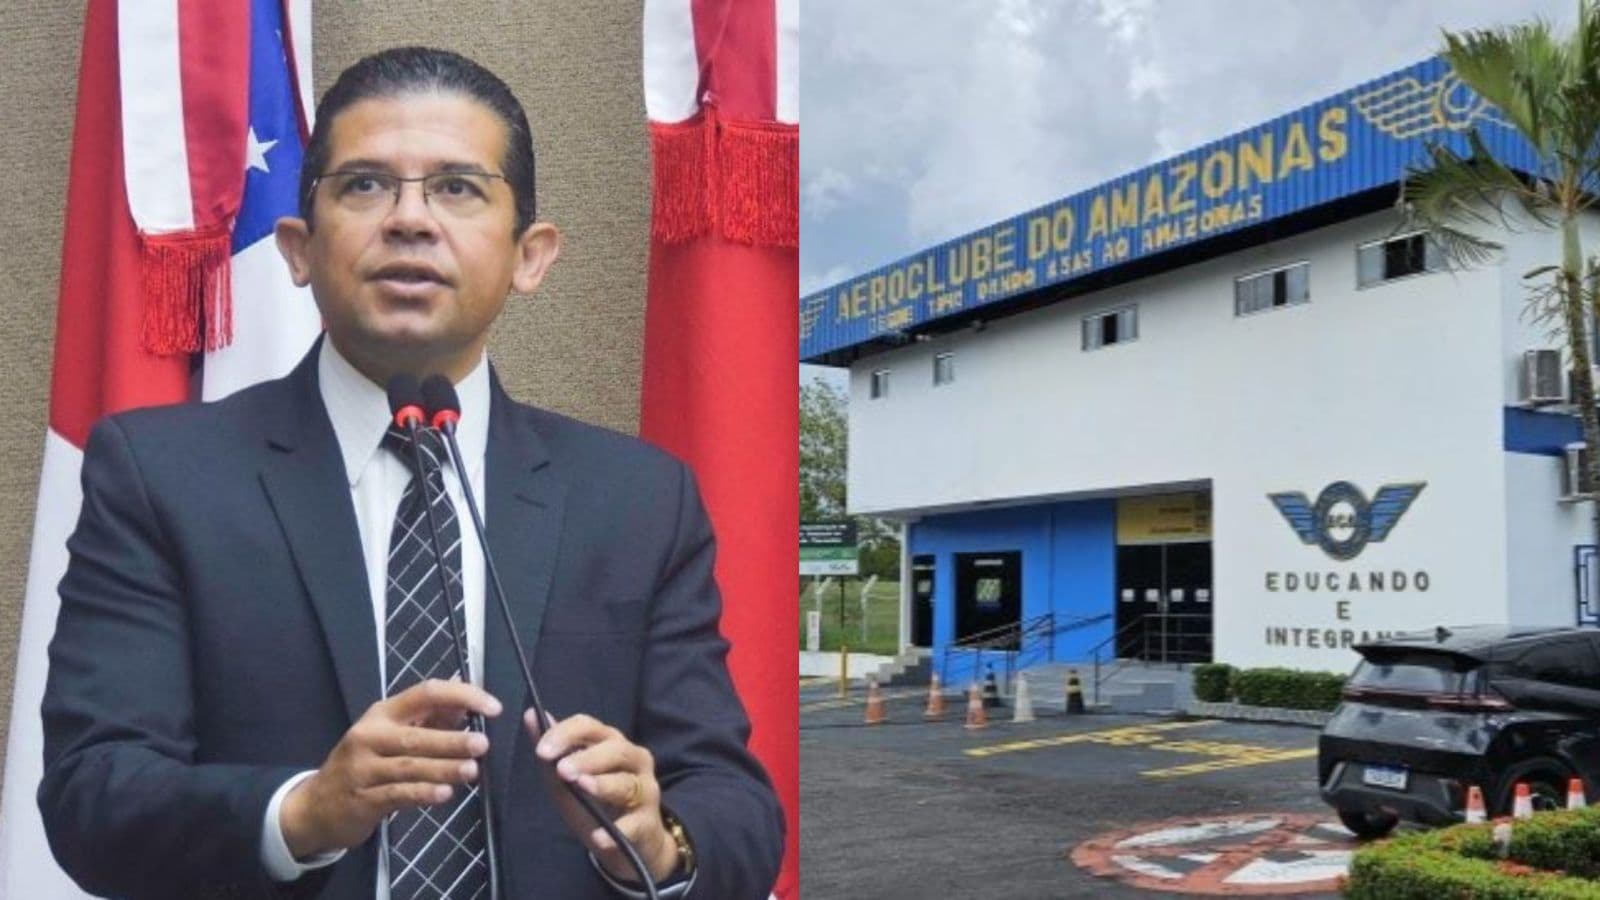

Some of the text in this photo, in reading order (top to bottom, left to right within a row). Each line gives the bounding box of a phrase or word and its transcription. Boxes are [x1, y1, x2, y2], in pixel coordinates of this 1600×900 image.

[836, 107, 1348, 321] AEROCLUBE DO AMAZONAS
[1265, 571, 1431, 592] EDUCANDO
[1336, 601, 1352, 620] E
